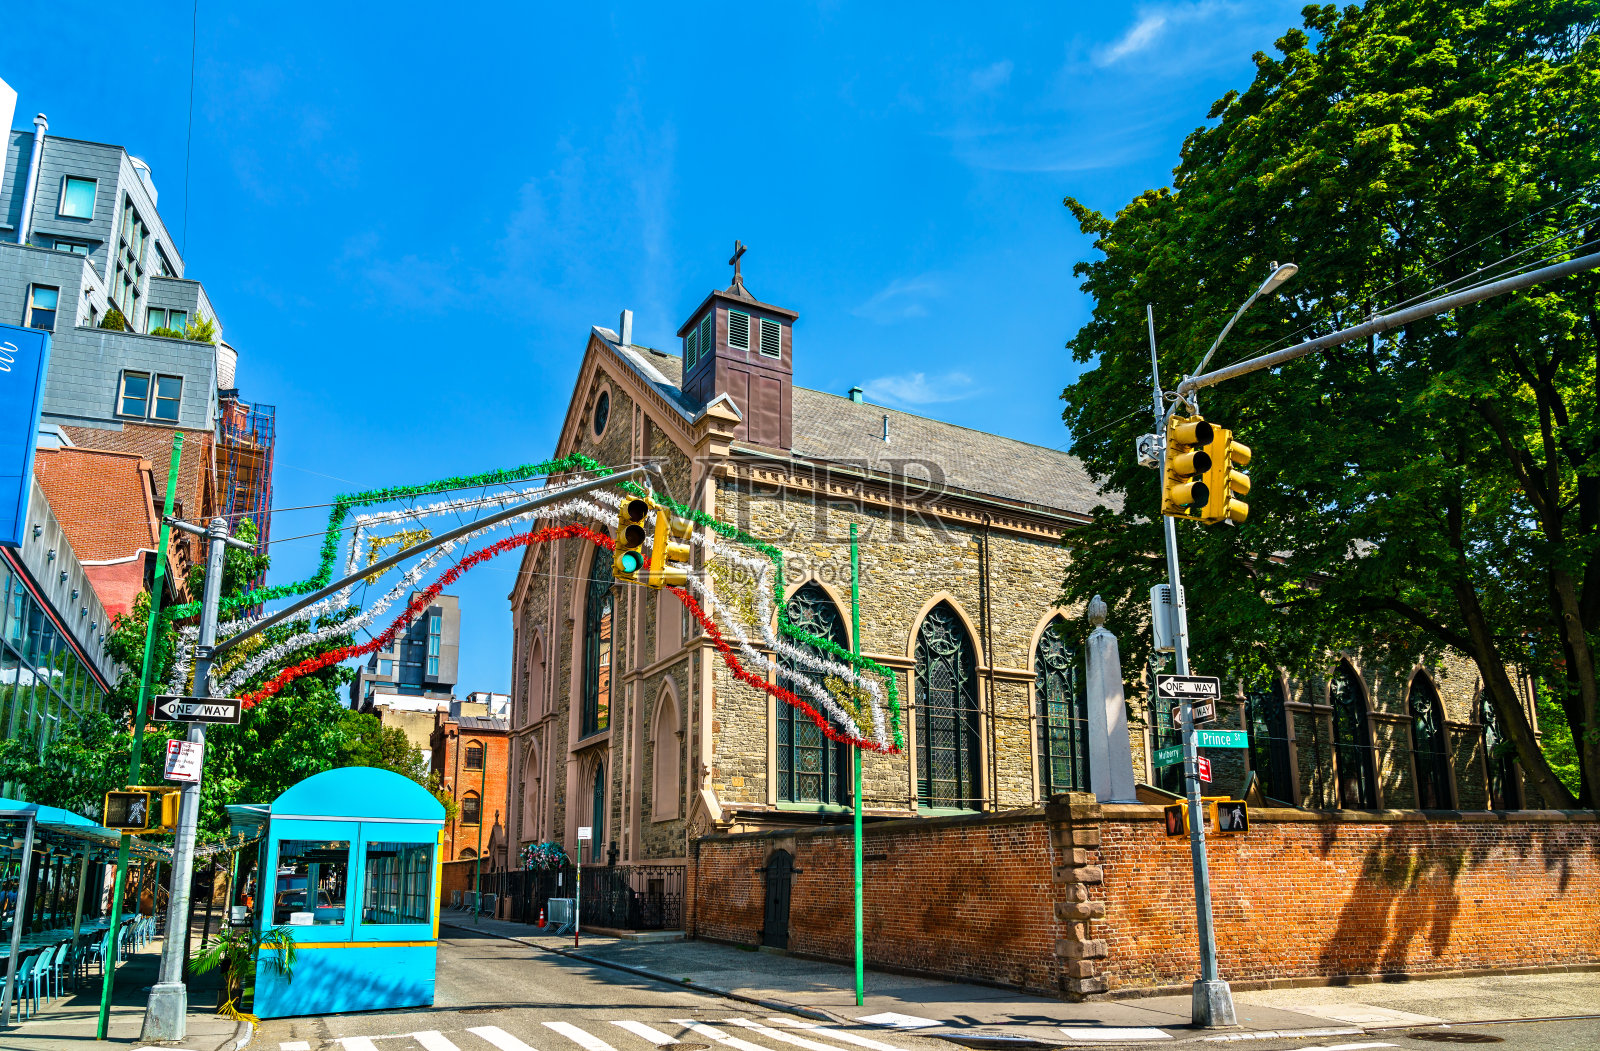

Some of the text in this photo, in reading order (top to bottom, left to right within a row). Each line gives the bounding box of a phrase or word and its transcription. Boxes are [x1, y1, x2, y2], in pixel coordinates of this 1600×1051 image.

[1166, 682, 1214, 692] ONE WAY
[168, 703, 230, 716] ONE WAY
[1196, 704, 1211, 717] WAY
[1202, 732, 1231, 746] Prince
